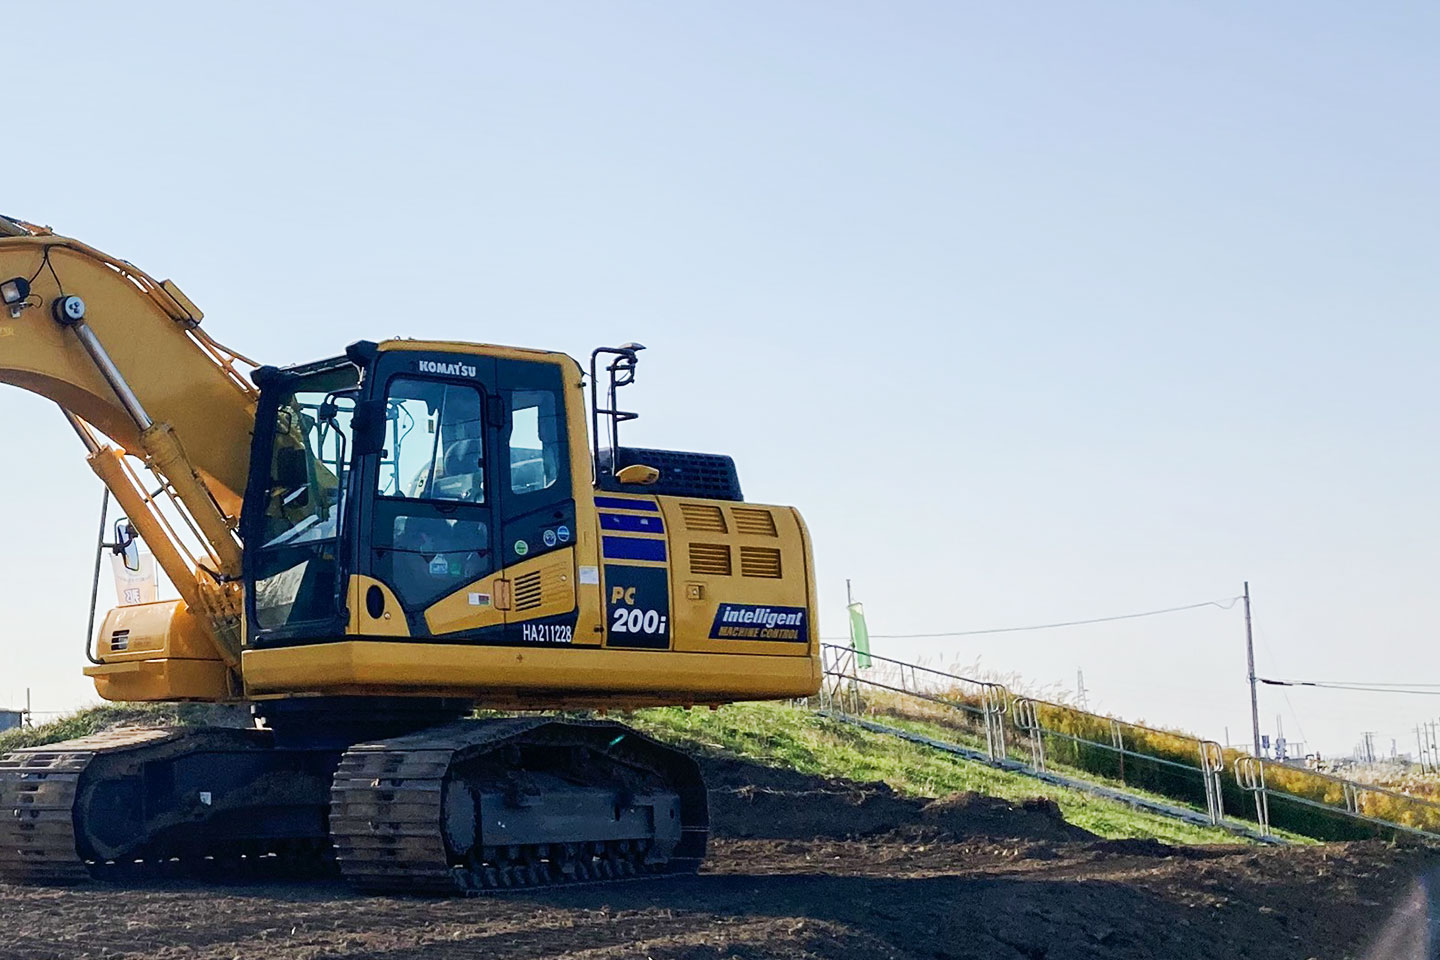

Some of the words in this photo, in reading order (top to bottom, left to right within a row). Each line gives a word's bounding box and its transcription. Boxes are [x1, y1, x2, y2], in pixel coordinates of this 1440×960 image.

[419, 360, 477, 377] KOMATSU
[611, 586, 636, 606] PC
[611, 607, 667, 634] 200i
[722, 606, 803, 628] intelligent
[522, 623, 572, 643] HA211228
